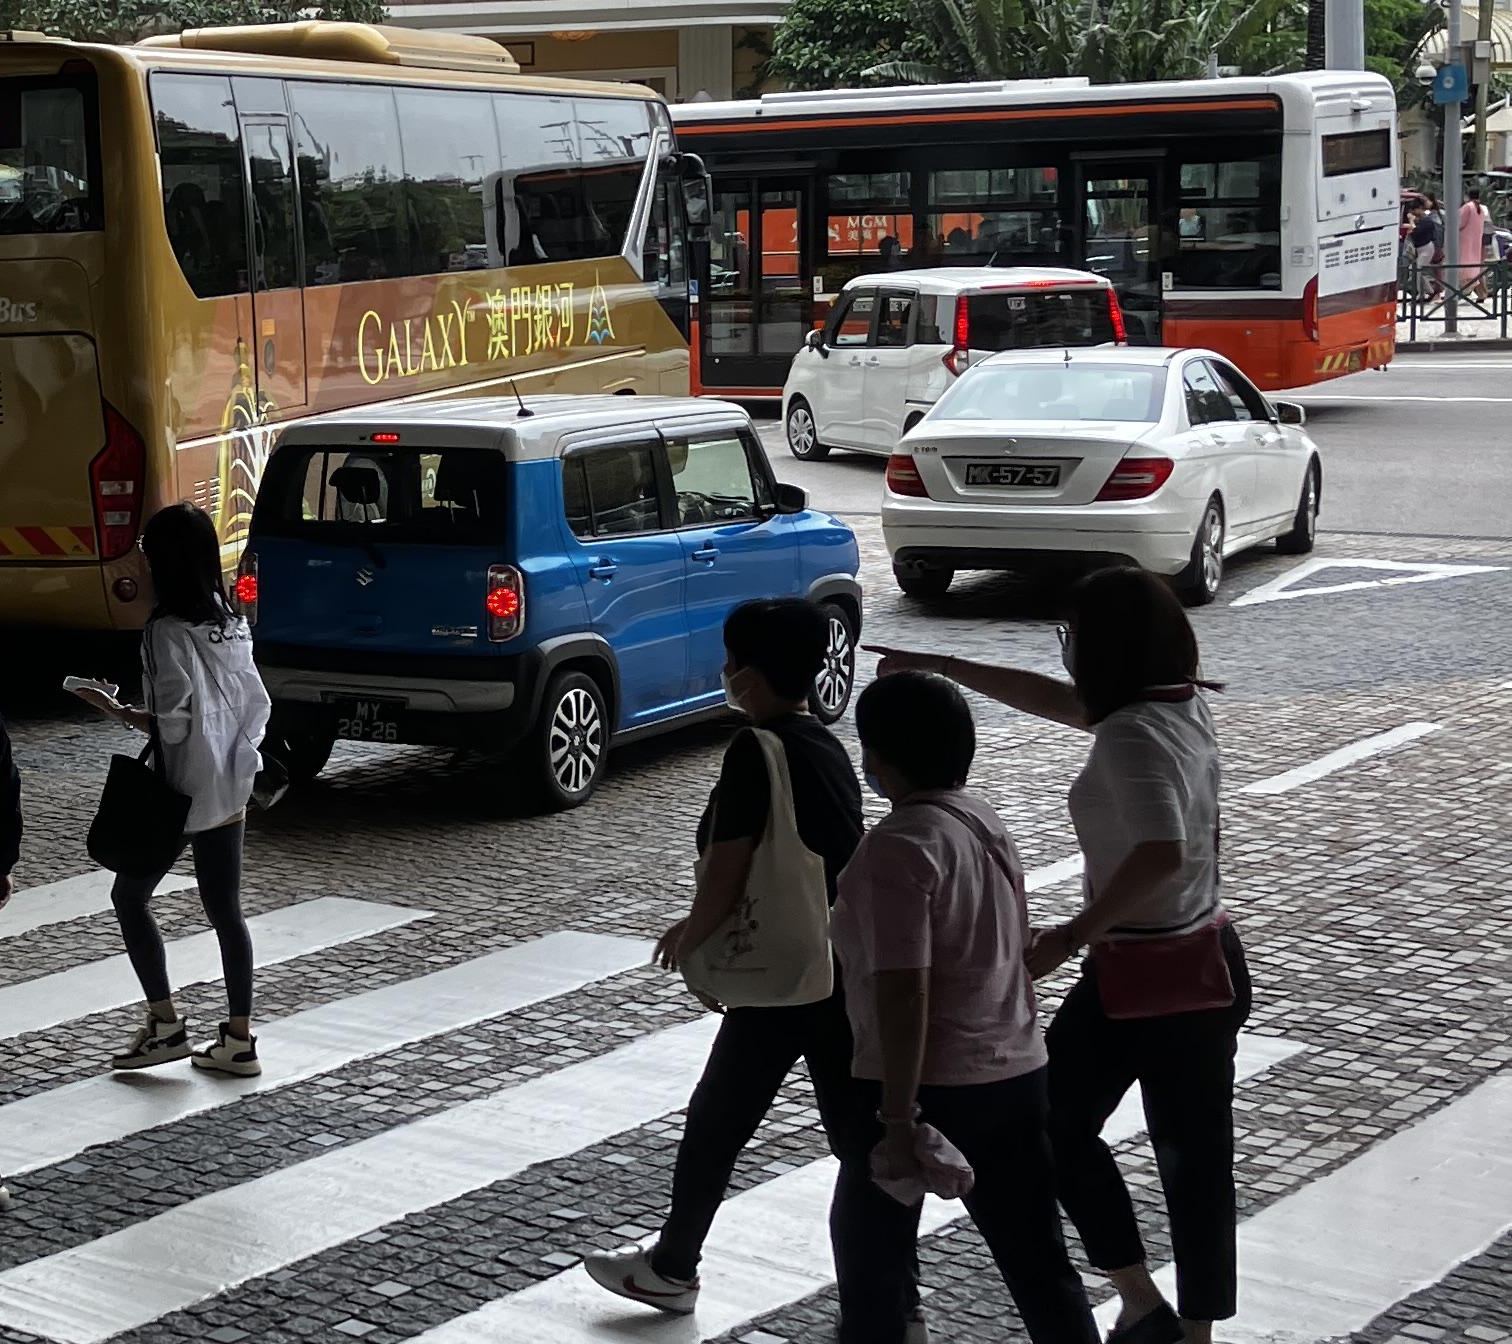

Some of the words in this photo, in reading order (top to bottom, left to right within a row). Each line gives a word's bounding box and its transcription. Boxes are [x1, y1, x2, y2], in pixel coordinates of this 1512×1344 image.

[846, 215, 888, 228] MGM
[486, 281, 574, 361] 澳門銀河
